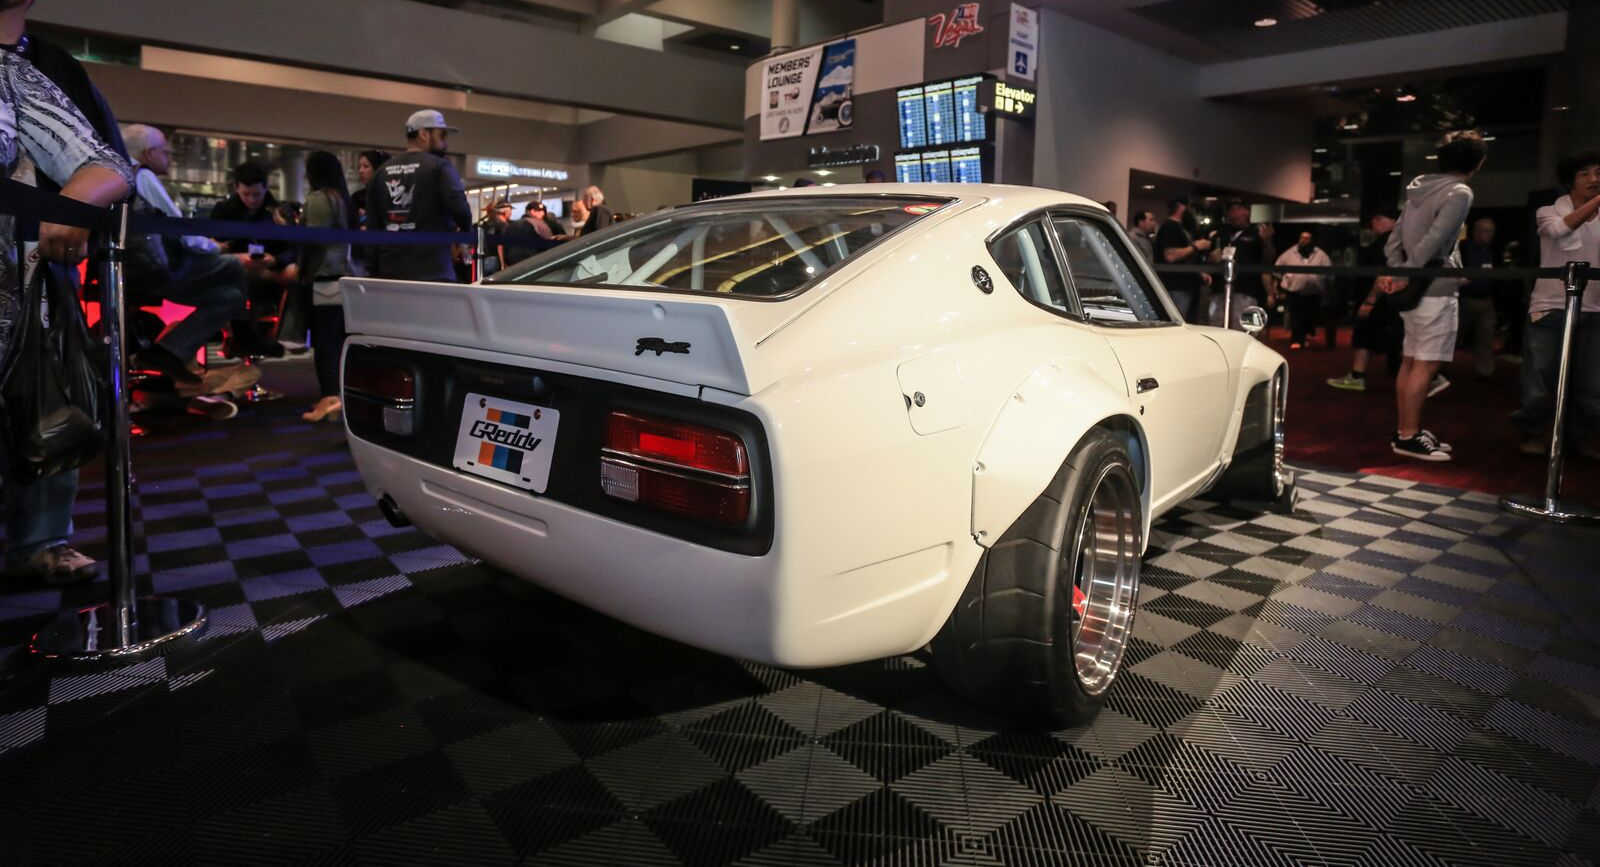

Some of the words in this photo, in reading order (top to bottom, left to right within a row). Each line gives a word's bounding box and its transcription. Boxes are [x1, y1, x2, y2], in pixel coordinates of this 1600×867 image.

[768, 53, 815, 76] MEMBERS'
[767, 71, 803, 89] LOUNGE
[994, 81, 1036, 104] Elevator
[469, 419, 542, 452] GReddy
